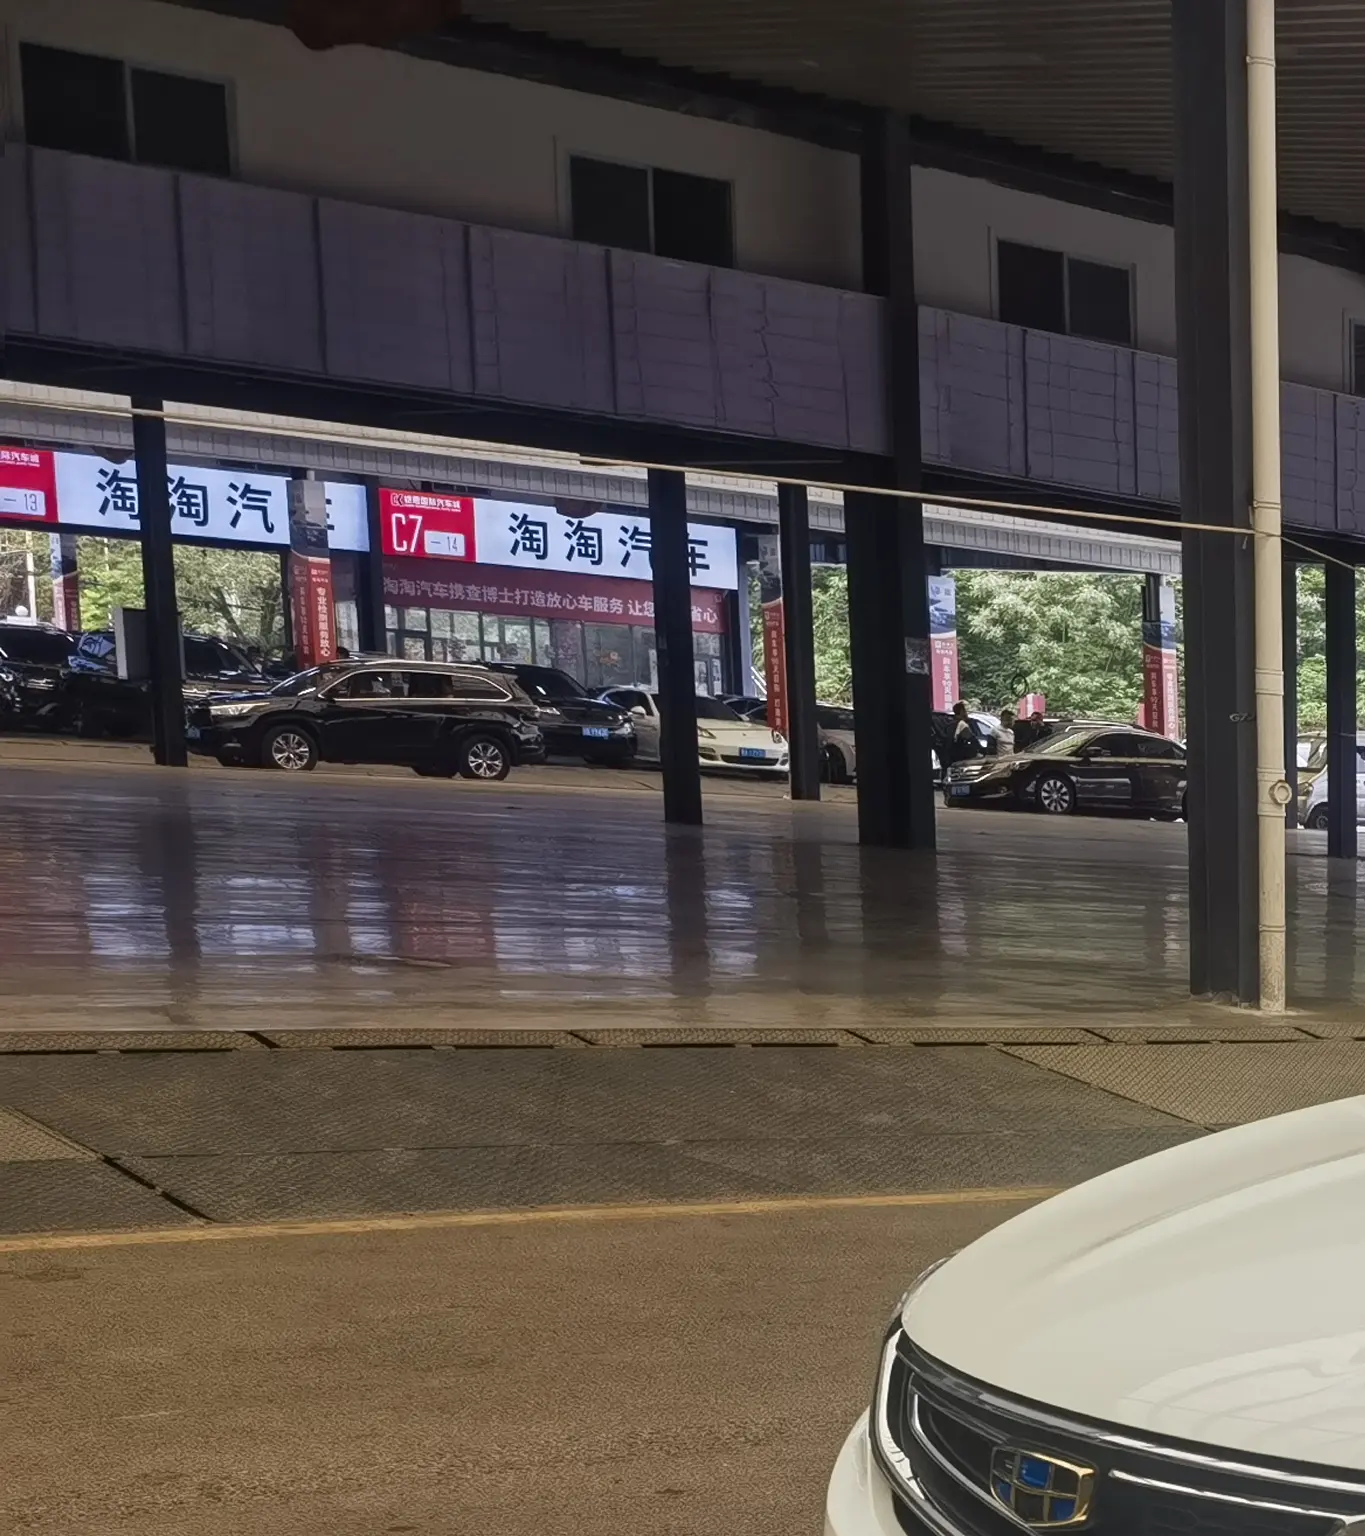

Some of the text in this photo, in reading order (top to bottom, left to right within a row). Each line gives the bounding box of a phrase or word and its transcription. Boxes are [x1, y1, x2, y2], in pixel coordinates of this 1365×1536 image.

[96, 468, 334, 534] 淘淘汽
[391, 513, 422, 552] C7
